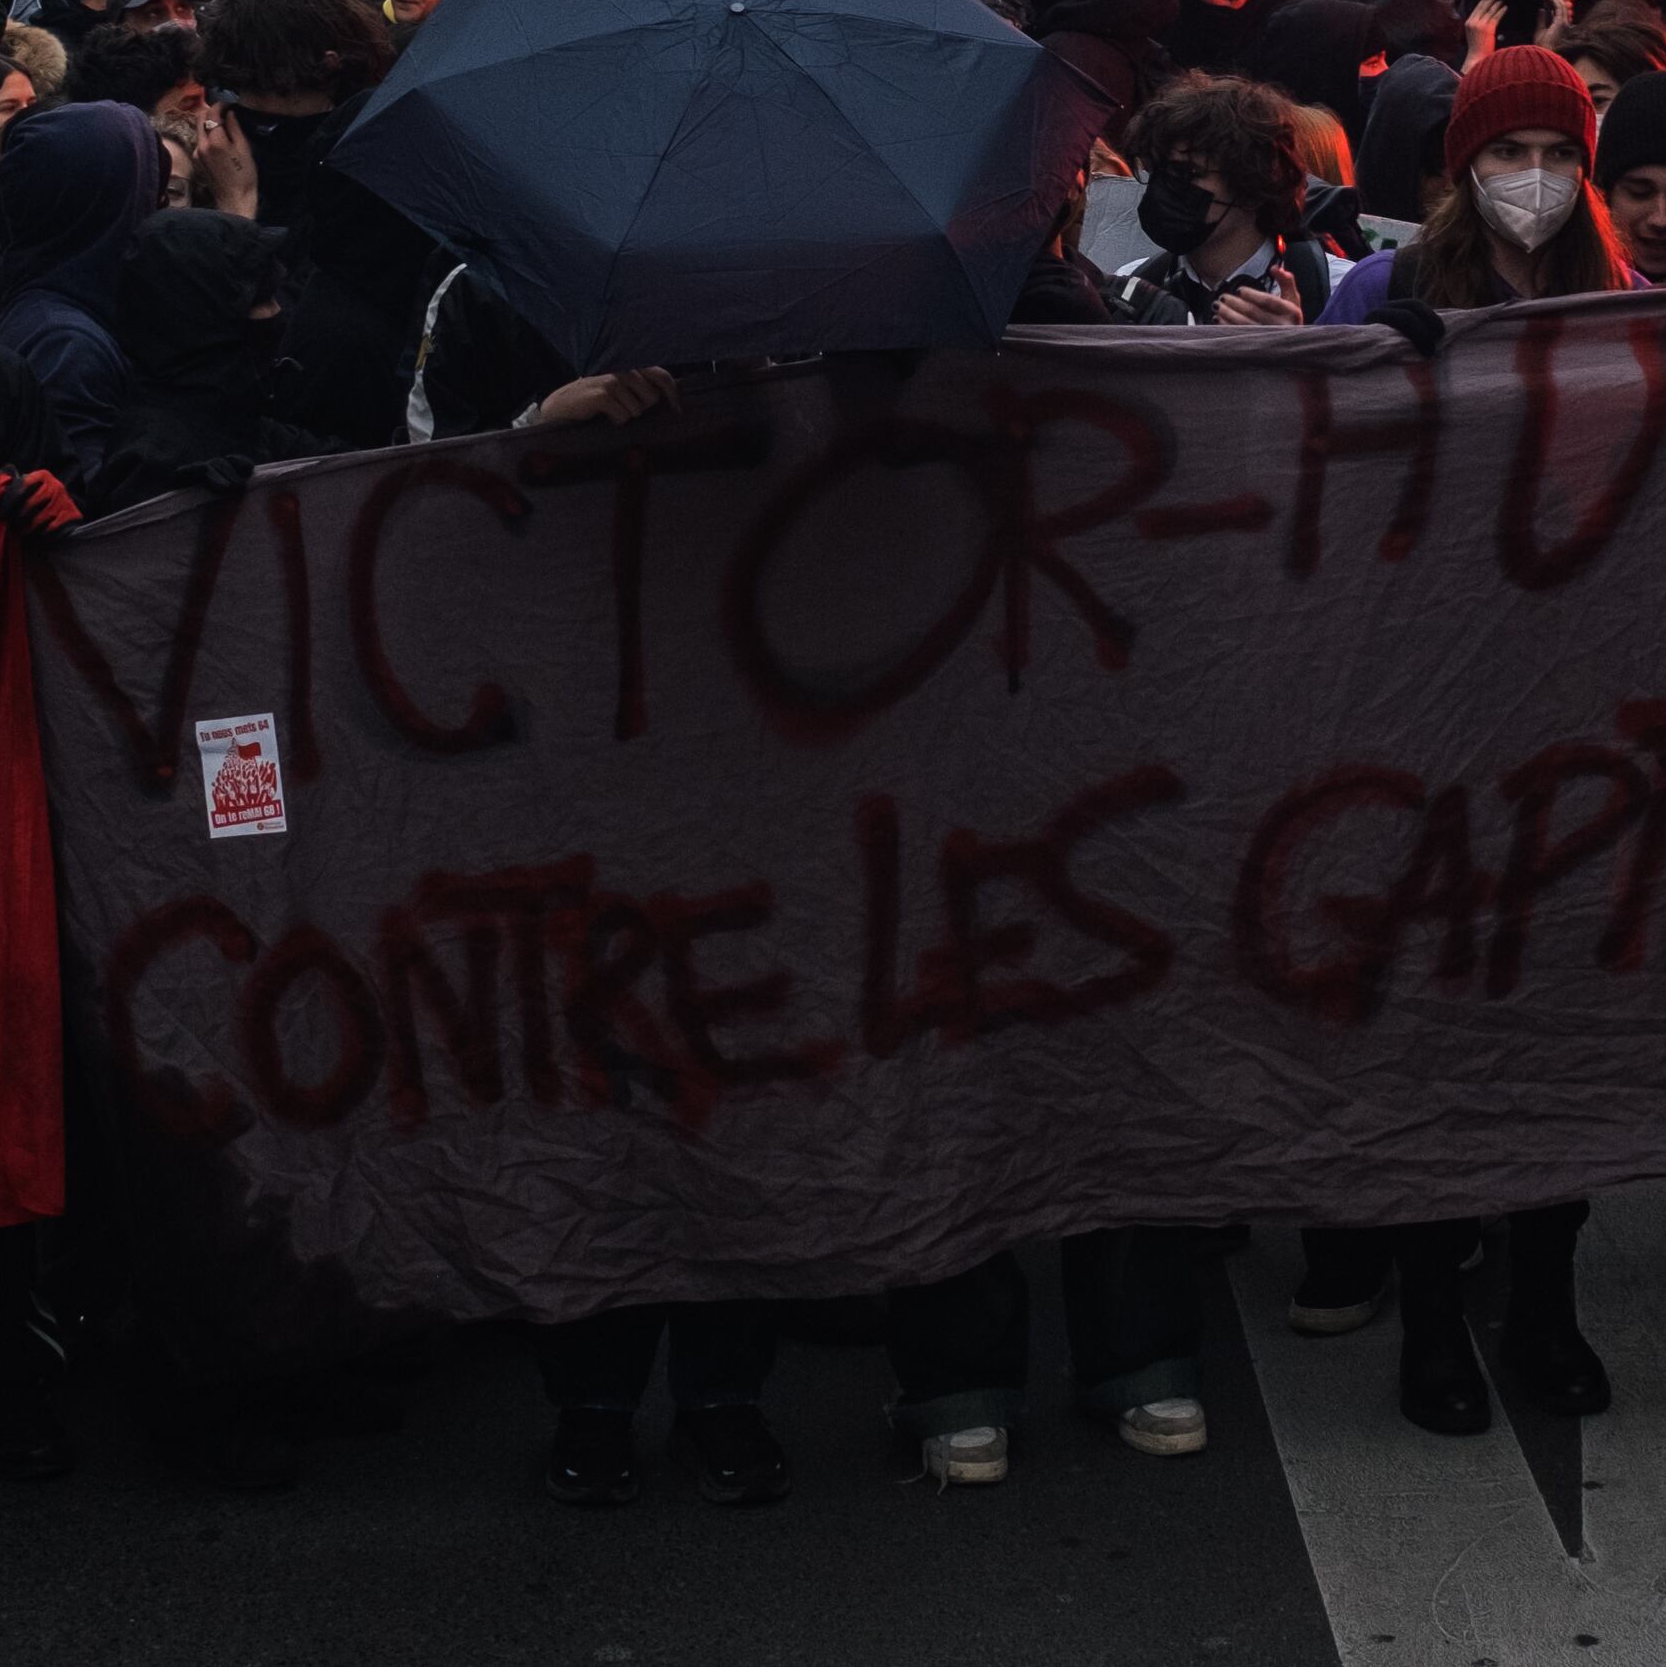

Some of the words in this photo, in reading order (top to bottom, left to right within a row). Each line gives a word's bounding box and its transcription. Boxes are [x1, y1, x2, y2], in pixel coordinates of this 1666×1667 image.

[200, 731, 211, 742] Tu
[212, 727, 233, 739] nous
[258, 719, 269, 730] 64
[103, 851, 850, 1141] CONTRE
[853, 761, 1183, 1058] LES
